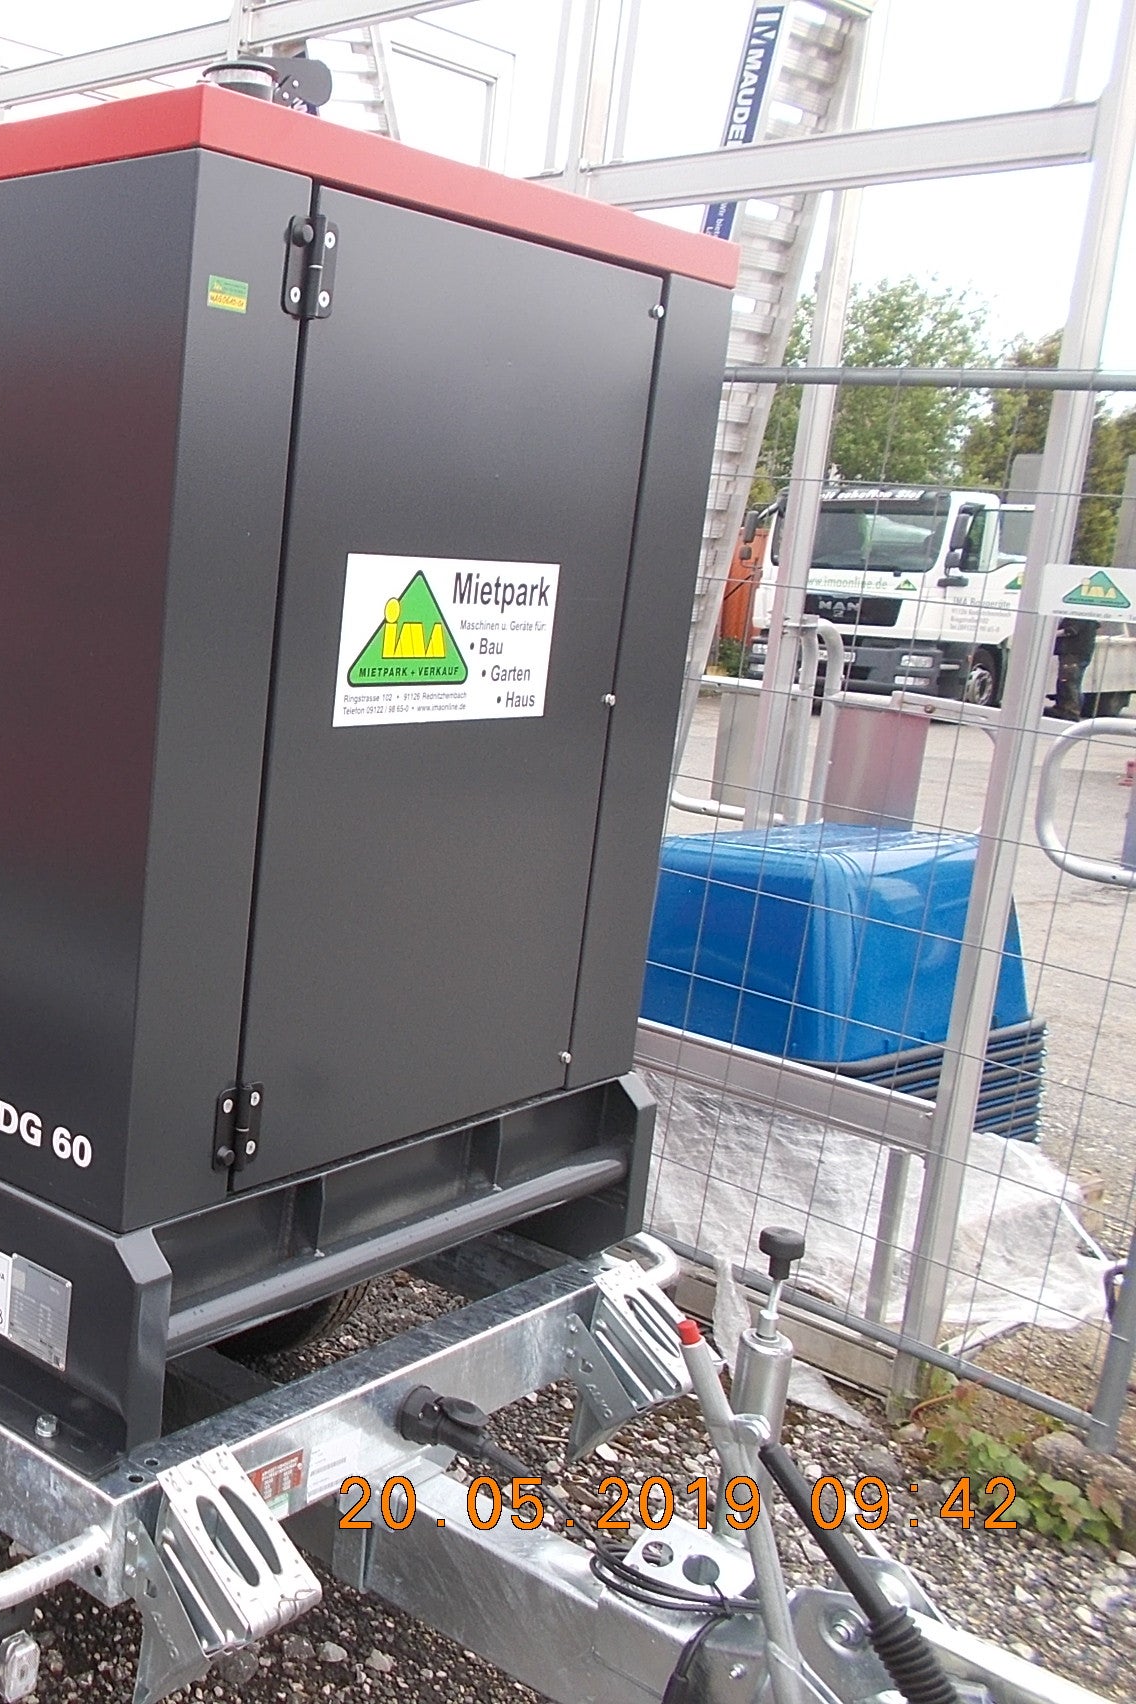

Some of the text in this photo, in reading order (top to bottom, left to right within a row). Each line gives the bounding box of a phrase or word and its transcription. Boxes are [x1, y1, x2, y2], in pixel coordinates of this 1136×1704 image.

[453, 572, 550, 613] Mietpark
[819, 600, 861, 612] MAN
[460, 620, 499, 630] Maschinen
[510, 621, 533, 631] Geräte
[479, 638, 503, 655] Bau
[358, 667, 408, 678] MIETPARK
[418, 666, 459, 677] VERKAUF
[491, 665, 531, 682] Garten
[344, 694, 380, 704] Ringstrasse
[505, 692, 535, 708] Haus
[343, 707, 364, 715] Telefon
[52, 1126, 92, 1168] 60
